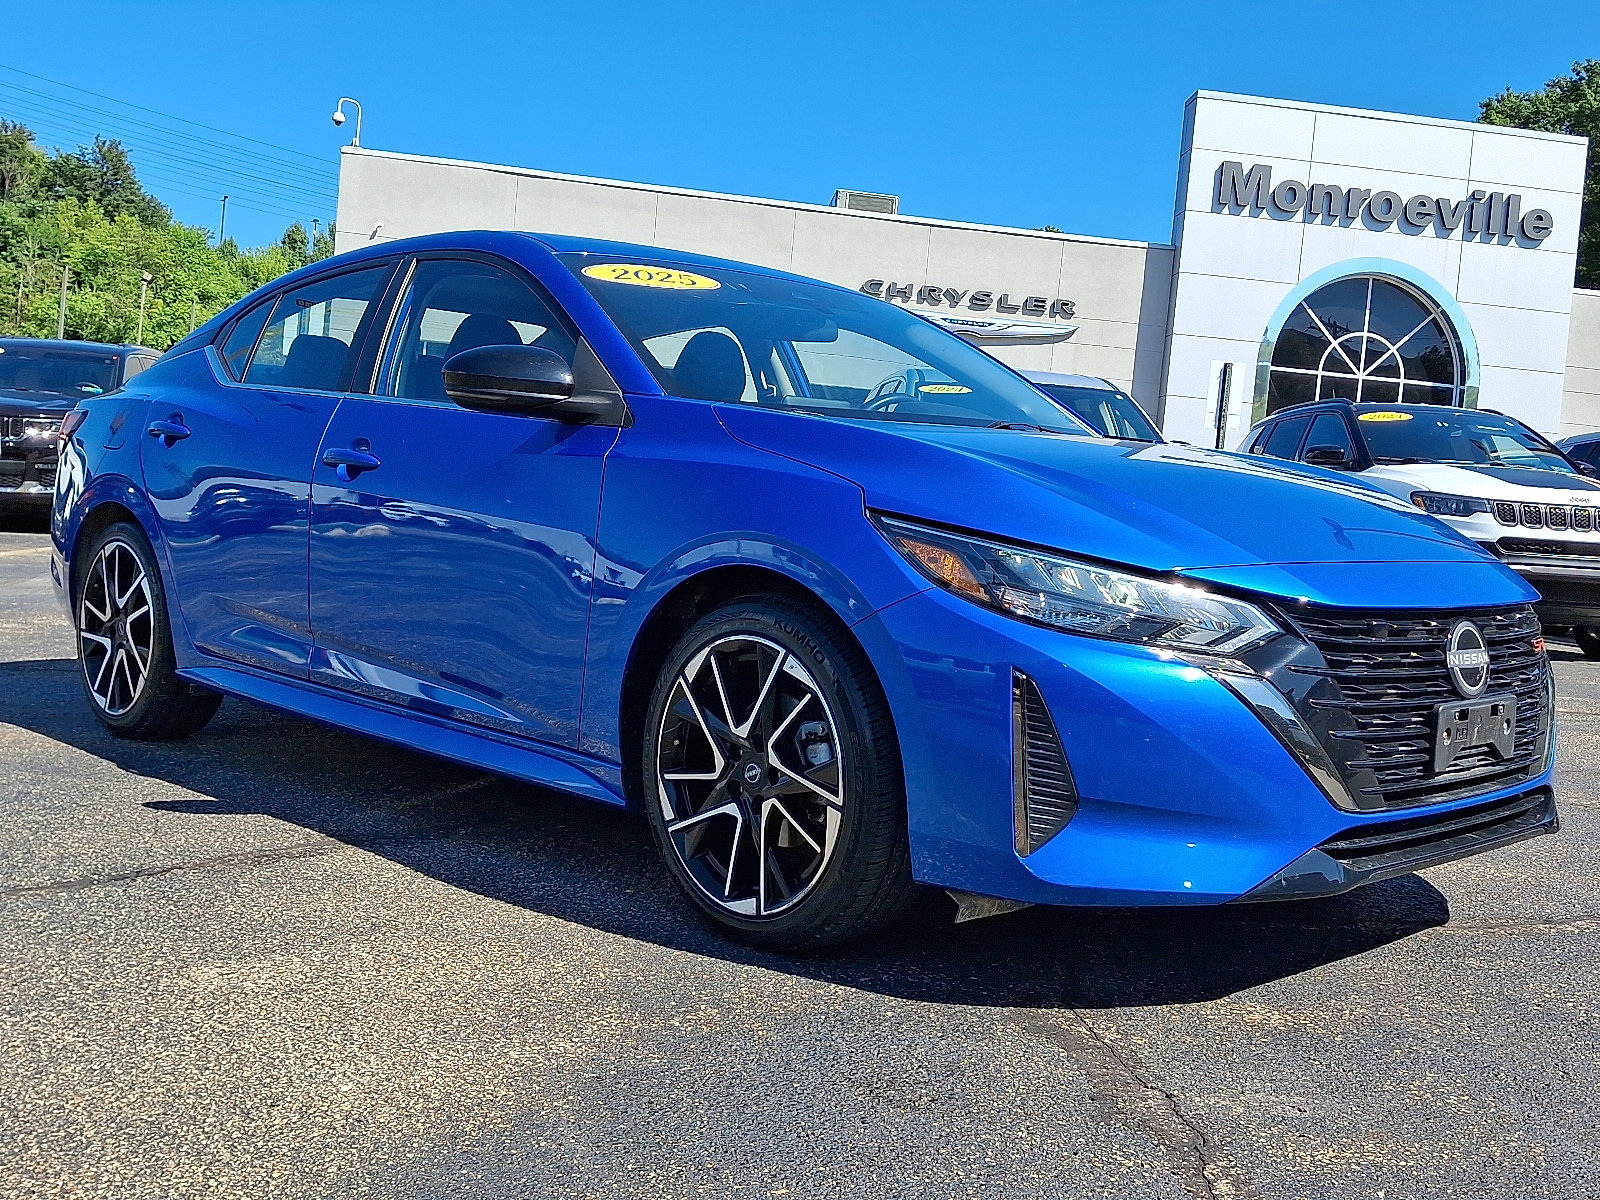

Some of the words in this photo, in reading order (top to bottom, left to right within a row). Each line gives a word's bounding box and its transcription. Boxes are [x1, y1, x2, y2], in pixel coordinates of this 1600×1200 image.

[1212, 161, 1554, 243] Monroeville
[611, 268, 697, 286] 2025
[861, 279, 1076, 319] CHRYSLER
[773, 617, 826, 665] KUMHO
[1450, 651, 1490, 665] NISSAN
